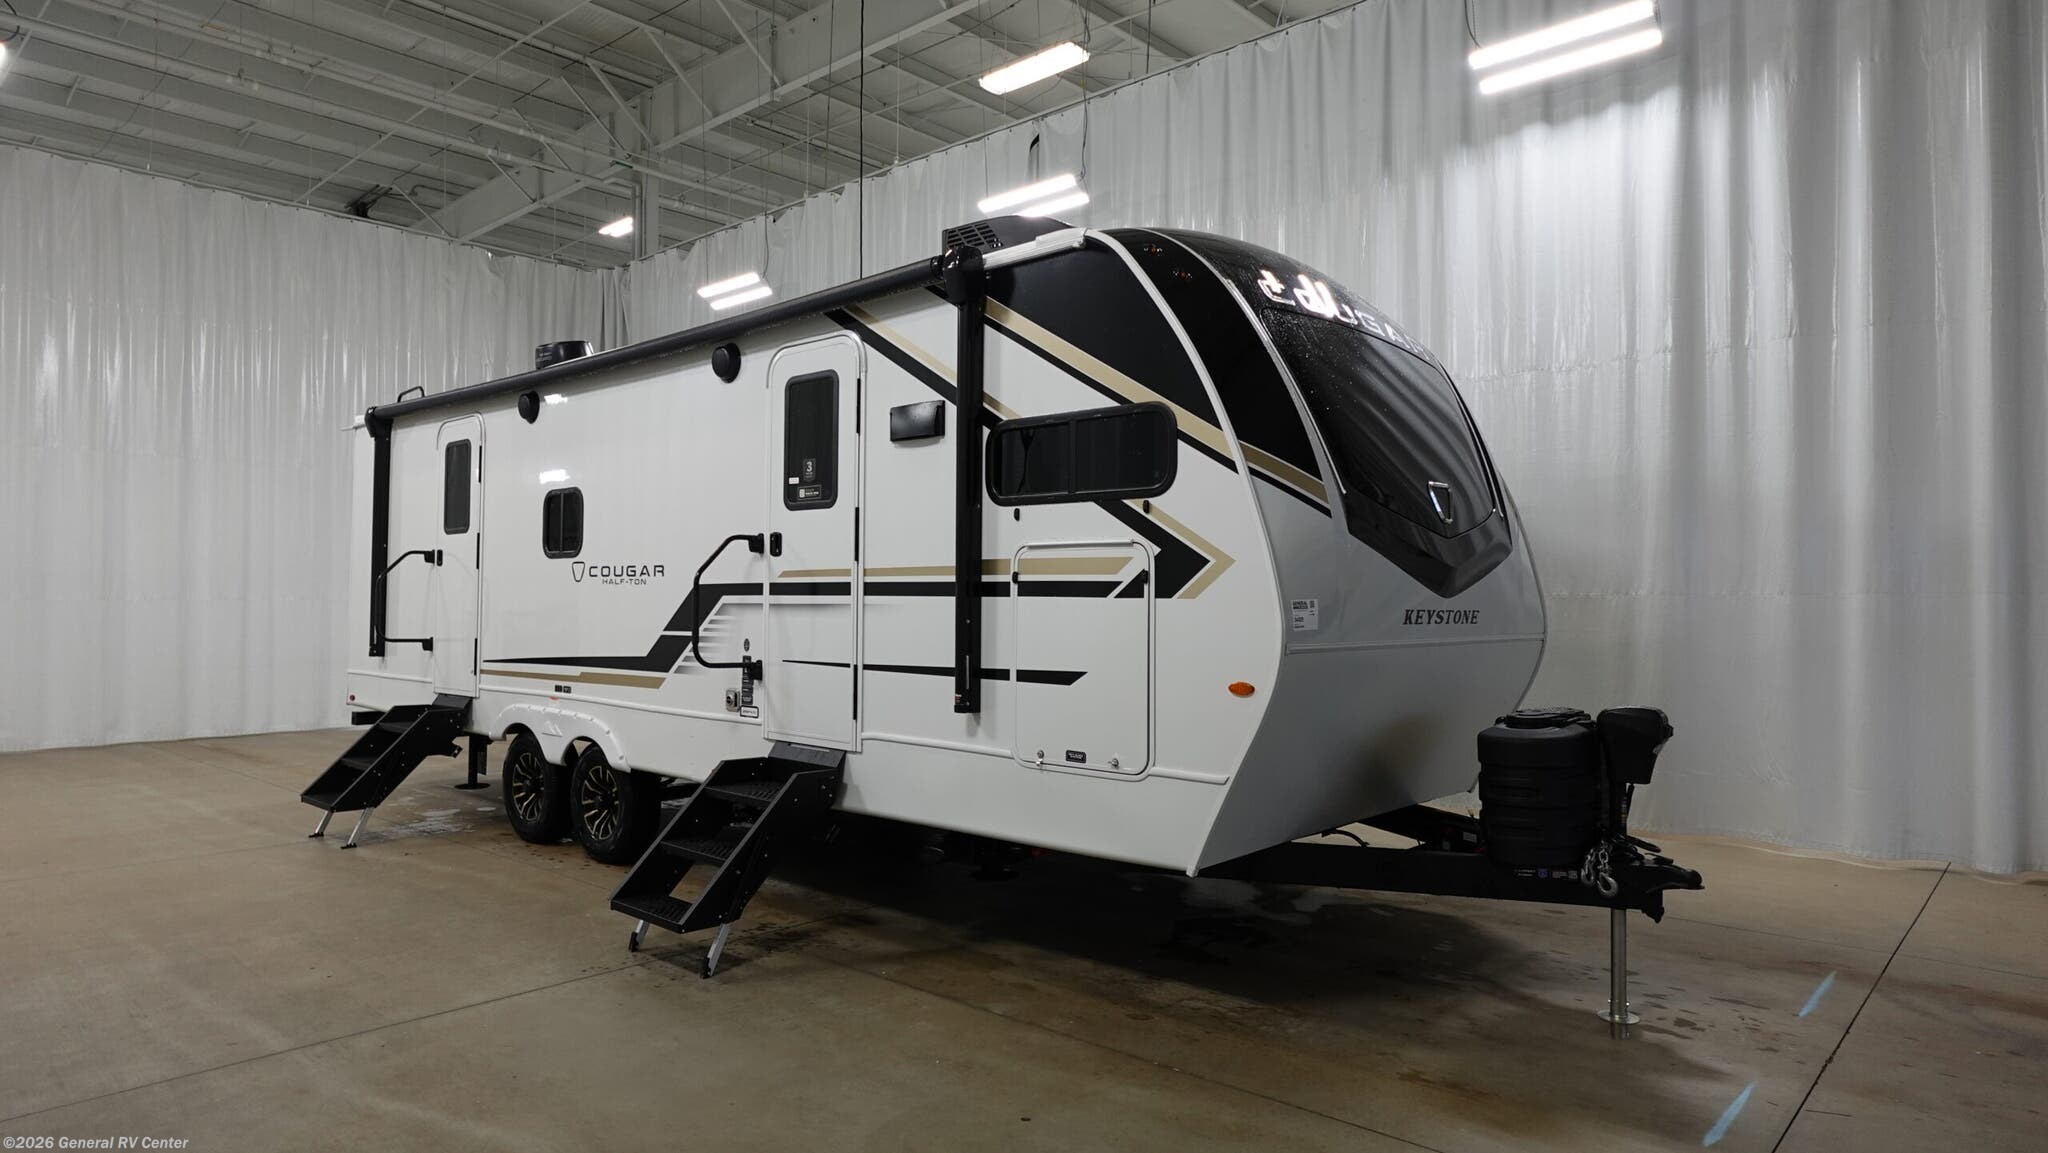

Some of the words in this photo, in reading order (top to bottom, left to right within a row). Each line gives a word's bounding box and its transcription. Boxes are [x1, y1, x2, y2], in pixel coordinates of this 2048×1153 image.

[806, 461, 813, 472] 3
[589, 565, 665, 577] COUGAR
[1403, 609, 1480, 625] KEYSTONE
